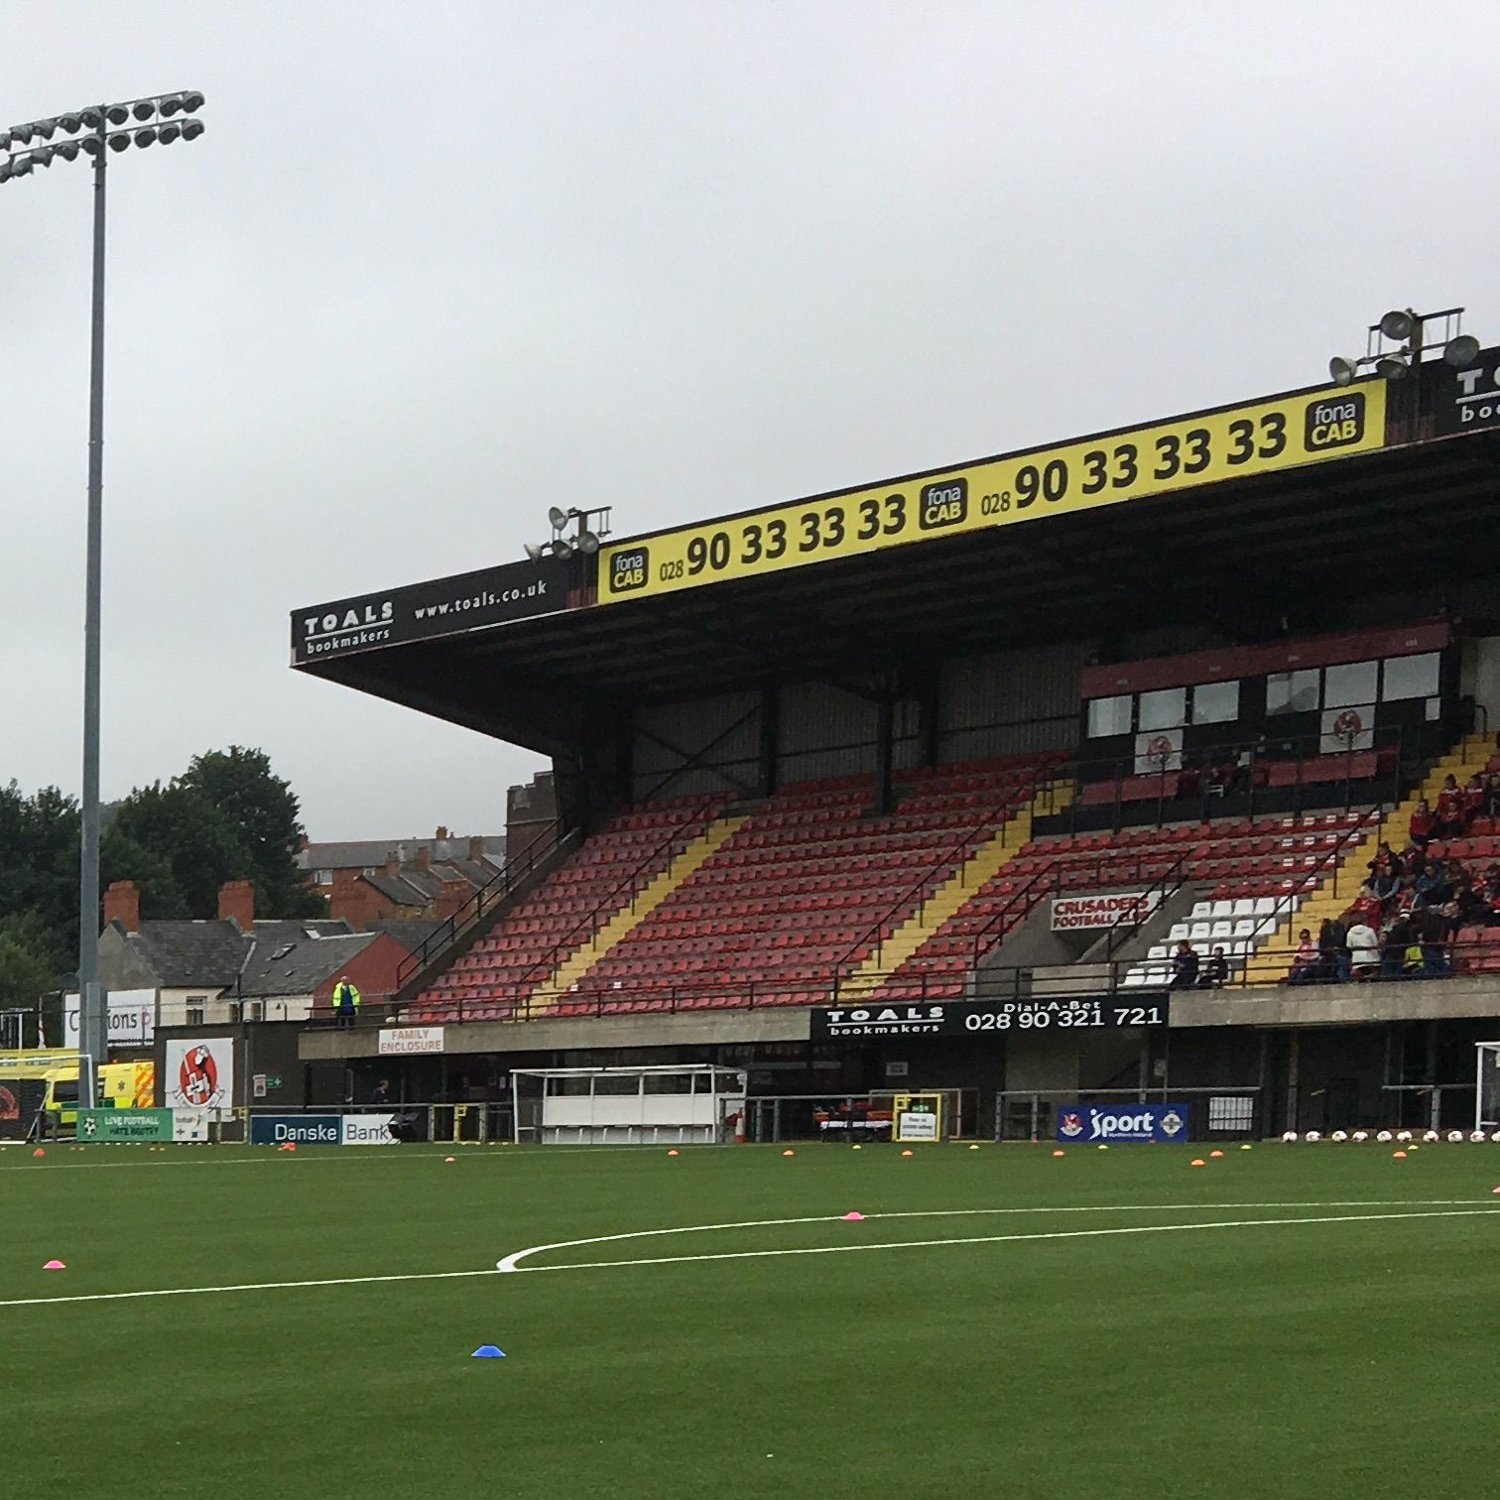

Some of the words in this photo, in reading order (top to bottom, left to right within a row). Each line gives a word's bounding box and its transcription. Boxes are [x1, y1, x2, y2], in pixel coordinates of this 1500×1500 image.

[1457, 367, 1500, 395] T
[1314, 403, 1357, 425] fona
[1311, 420, 1357, 446] CAB
[980, 490, 1011, 516] 028
[1015, 459, 1068, 509] 90
[1081, 444, 1138, 493] 33
[1153, 429, 1211, 480] 33
[1226, 412, 1287, 465] 33
[927, 486, 961, 506] fona
[925, 504, 961, 525] CAB
[659, 559, 684, 582] 028
[687, 532, 731, 576] 90
[741, 519, 787, 564] 33
[798, 507, 845, 552] 33
[857, 494, 907, 540] 33
[615, 553, 643, 573] fona
[613, 569, 644, 588] CAB
[304, 601, 394, 635] TOALS
[414, 580, 548, 620] www.toals.co.uk
[307, 628, 390, 655] bookmakers
[1054, 897, 1149, 916] CRUSADERS
[1054, 914, 1113, 928] FOOTBALL
[827, 1006, 945, 1022] TOALS
[1003, 1000, 1102, 1013] Dial-A-Bet
[965, 1013, 1011, 1031] 028
[1019, 1011, 1050, 1030] 90
[1058, 1009, 1104, 1028] 321
[1114, 1007, 1163, 1026] 721
[392, 1030, 430, 1040] FAMILY
[830, 1023, 940, 1036] bookmakers
[381, 1040, 441, 1051] ENCLOSURE
[274, 1123, 337, 1140] Danske
[347, 1123, 389, 1140] Bank
